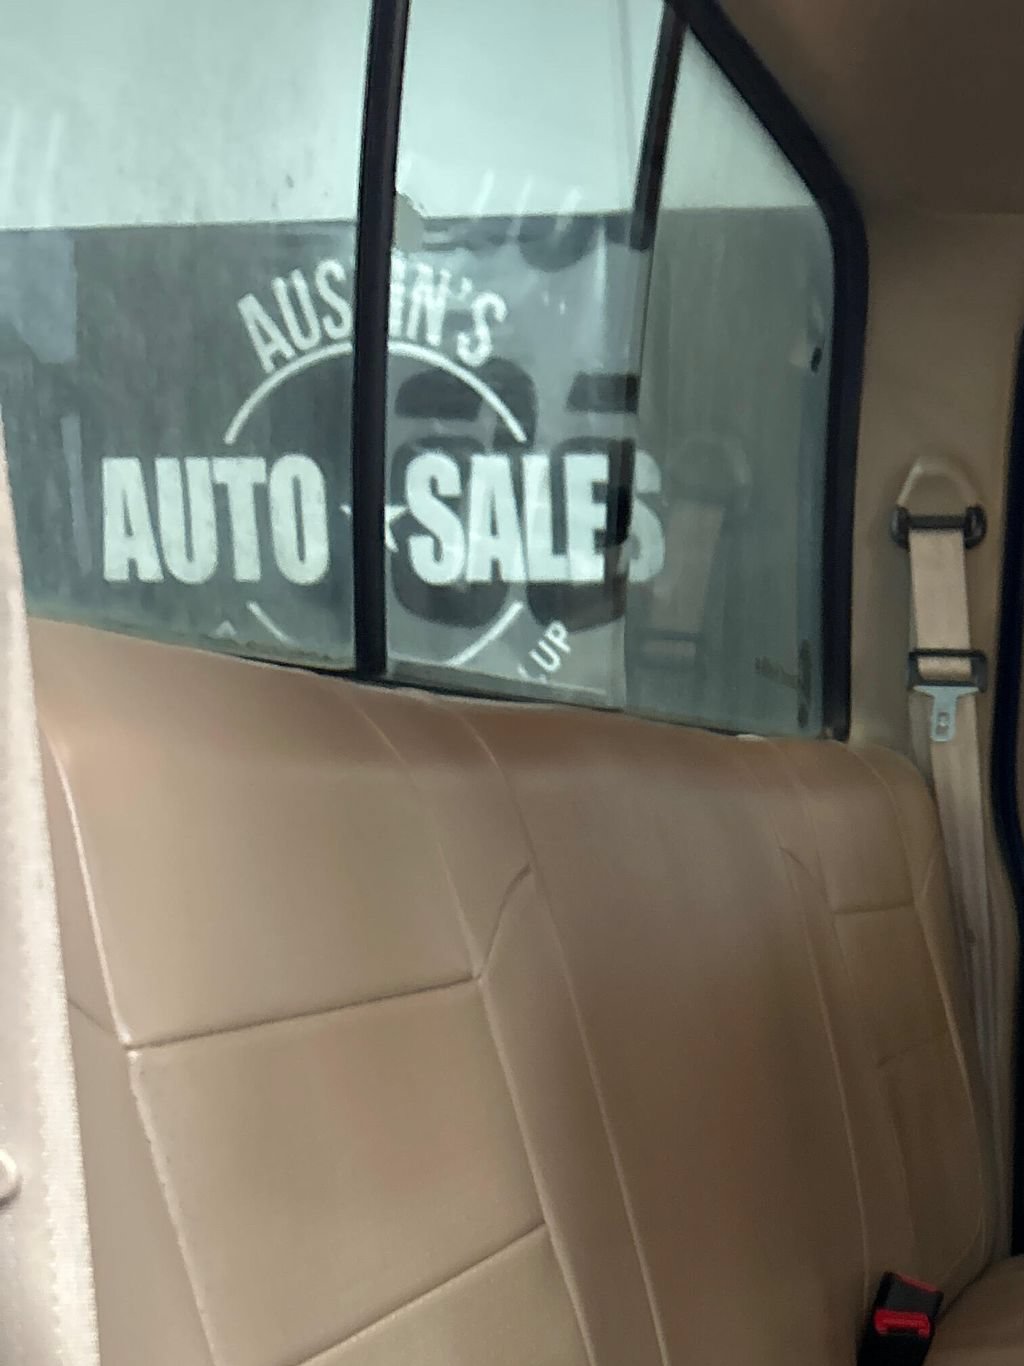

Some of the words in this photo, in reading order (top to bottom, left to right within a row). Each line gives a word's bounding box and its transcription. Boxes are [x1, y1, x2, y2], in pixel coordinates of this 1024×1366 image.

[237, 248, 508, 373] AUSIN'S
[102, 454, 331, 585] AUTO
[406, 454, 666, 586] SALES
